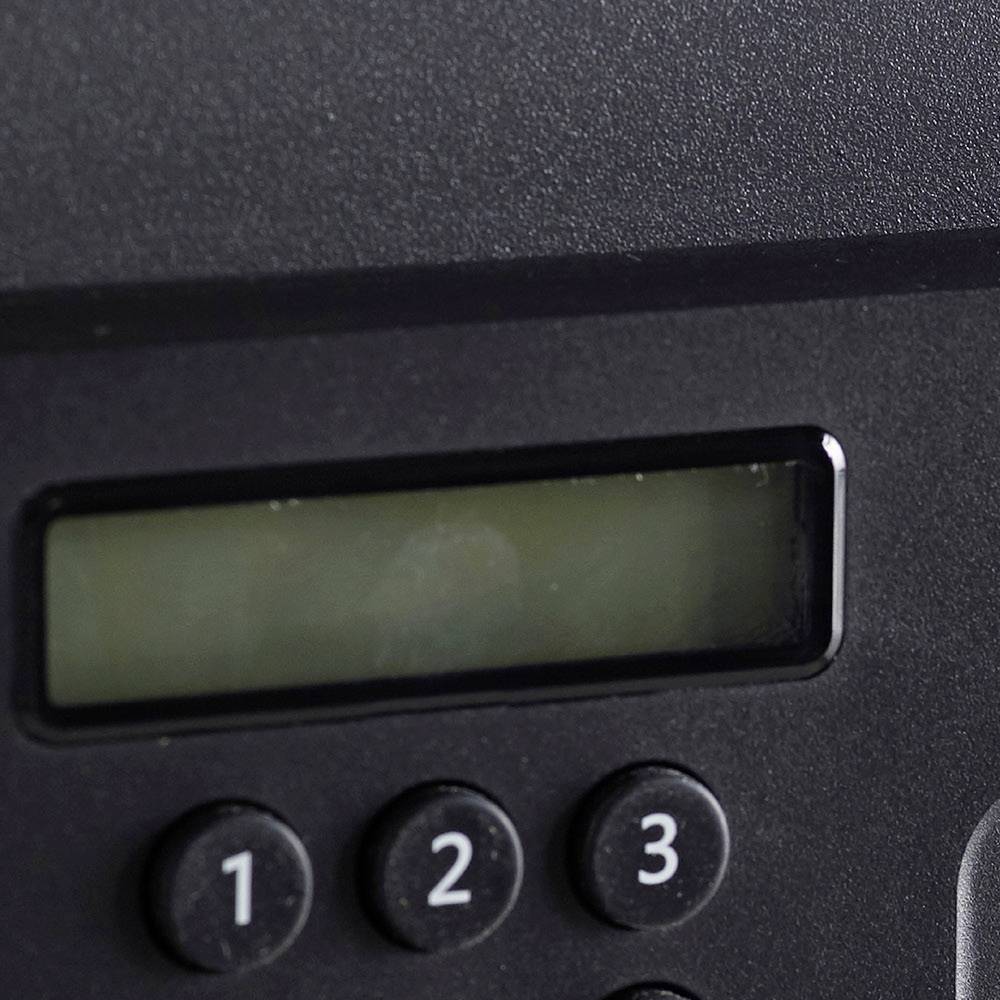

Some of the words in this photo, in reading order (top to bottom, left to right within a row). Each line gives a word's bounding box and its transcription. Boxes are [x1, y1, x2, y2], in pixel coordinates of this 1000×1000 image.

[427, 831, 473, 907] 2
[638, 812, 679, 885] 3
[221, 851, 253, 926] 1
